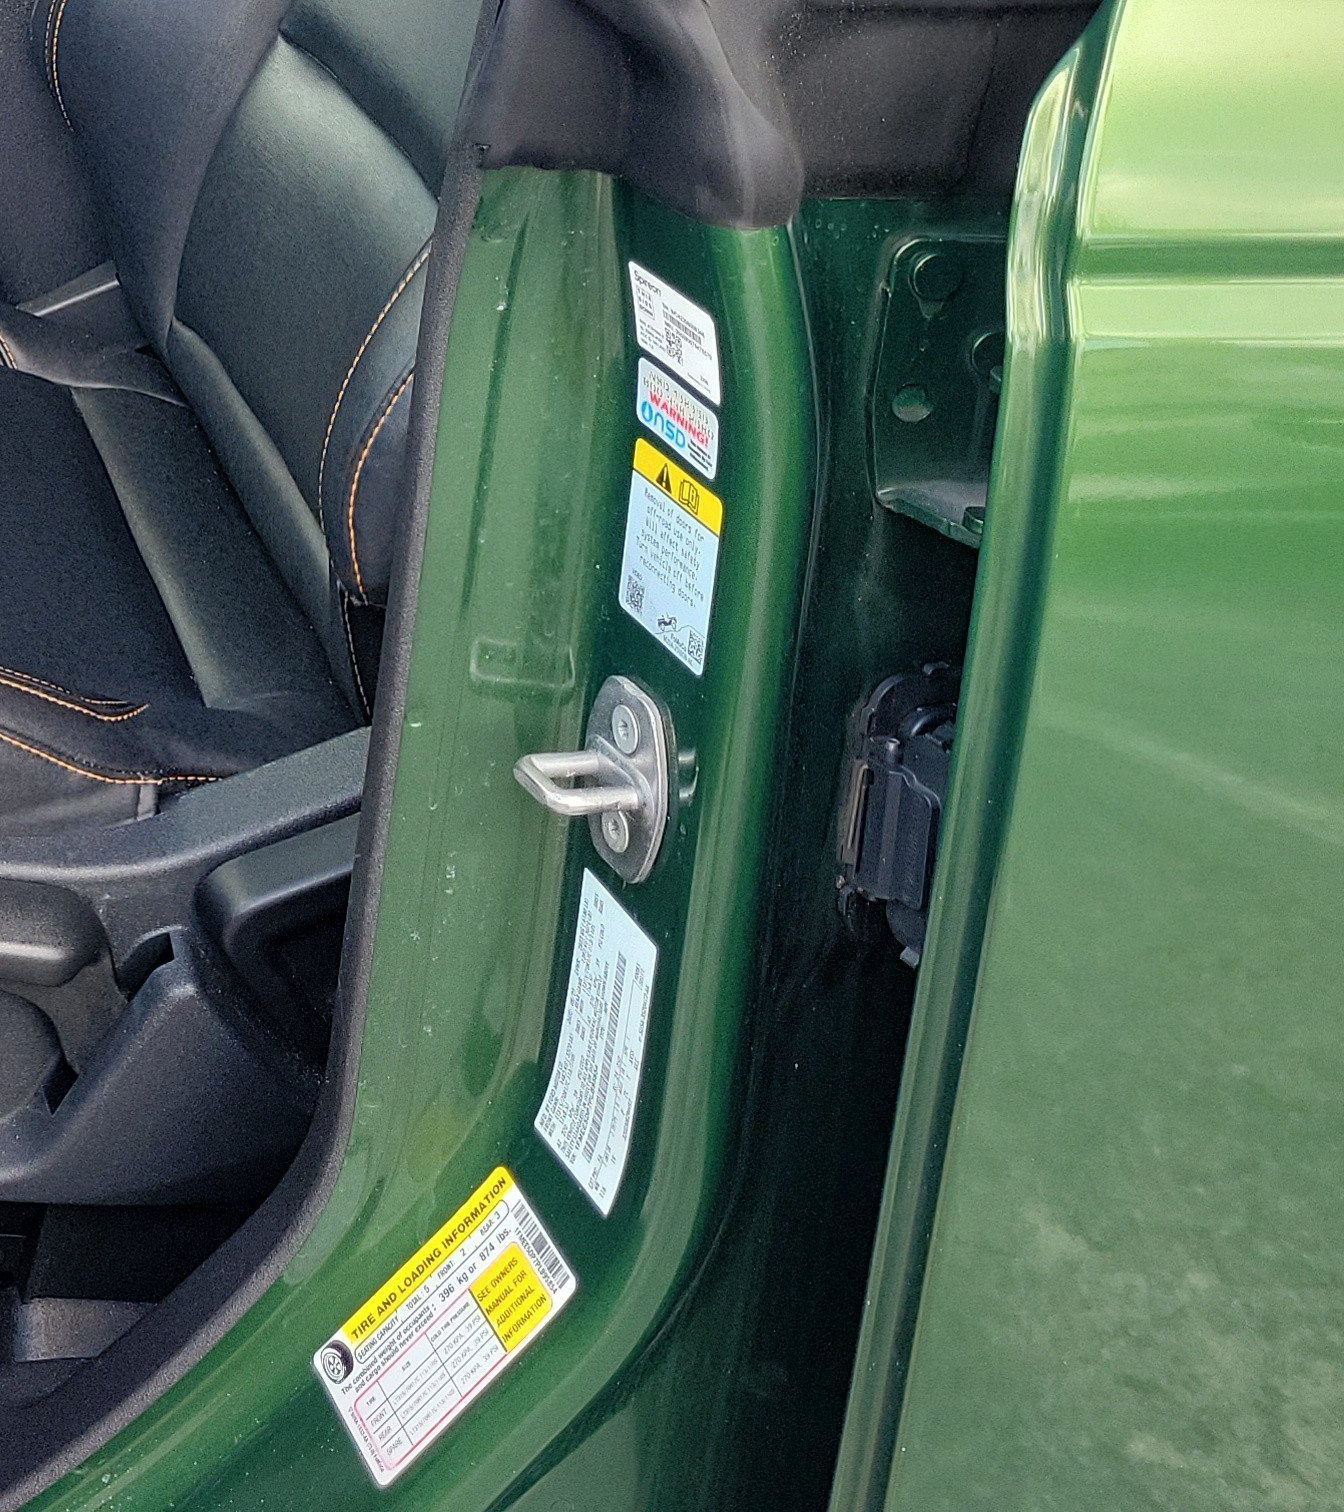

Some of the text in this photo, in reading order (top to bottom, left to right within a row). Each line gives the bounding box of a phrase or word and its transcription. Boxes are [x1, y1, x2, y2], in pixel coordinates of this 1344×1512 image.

[649, 391, 709, 447] WARNING!
[643, 486, 705, 545] Removal of doors for
[646, 502, 701, 558] off-road use only.
[634, 534, 704, 602] Turn vehicle off before
[640, 527, 660, 552] system
[660, 544, 698, 584] performance.
[659, 528, 679, 552] affect
[680, 546, 700, 572] safety
[638, 553, 675, 594] reconnecting
[677, 585, 696, 610] doors.
[350, 1175, 509, 1342] TIRE AND LOADING INFORMATION
[356, 1335, 378, 1361] SEATING
[375, 1313, 400, 1341] CAPACITY
[458, 1246, 467, 1257] 2
[492, 1209, 501, 1220] 3
[437, 1223, 512, 1303] 396 kg or 874 lbs.
[475, 1255, 519, 1303] SEE OWNERS
[484, 1267, 528, 1316] MANUAL FOR
[493, 1282, 535, 1329] ADDITIONAL
[500, 1292, 548, 1344] INFORMATION
[340, 1303, 431, 1396] The combined weight of occupants
[353, 1378, 366, 1394] and
[364, 1364, 381, 1384] cargo
[379, 1343, 400, 1367] should
[397, 1328, 416, 1350] never
[369, 1407, 388, 1429] FRONT
[377, 1423, 392, 1442] REAR
[385, 1435, 404, 1457] SPARE
